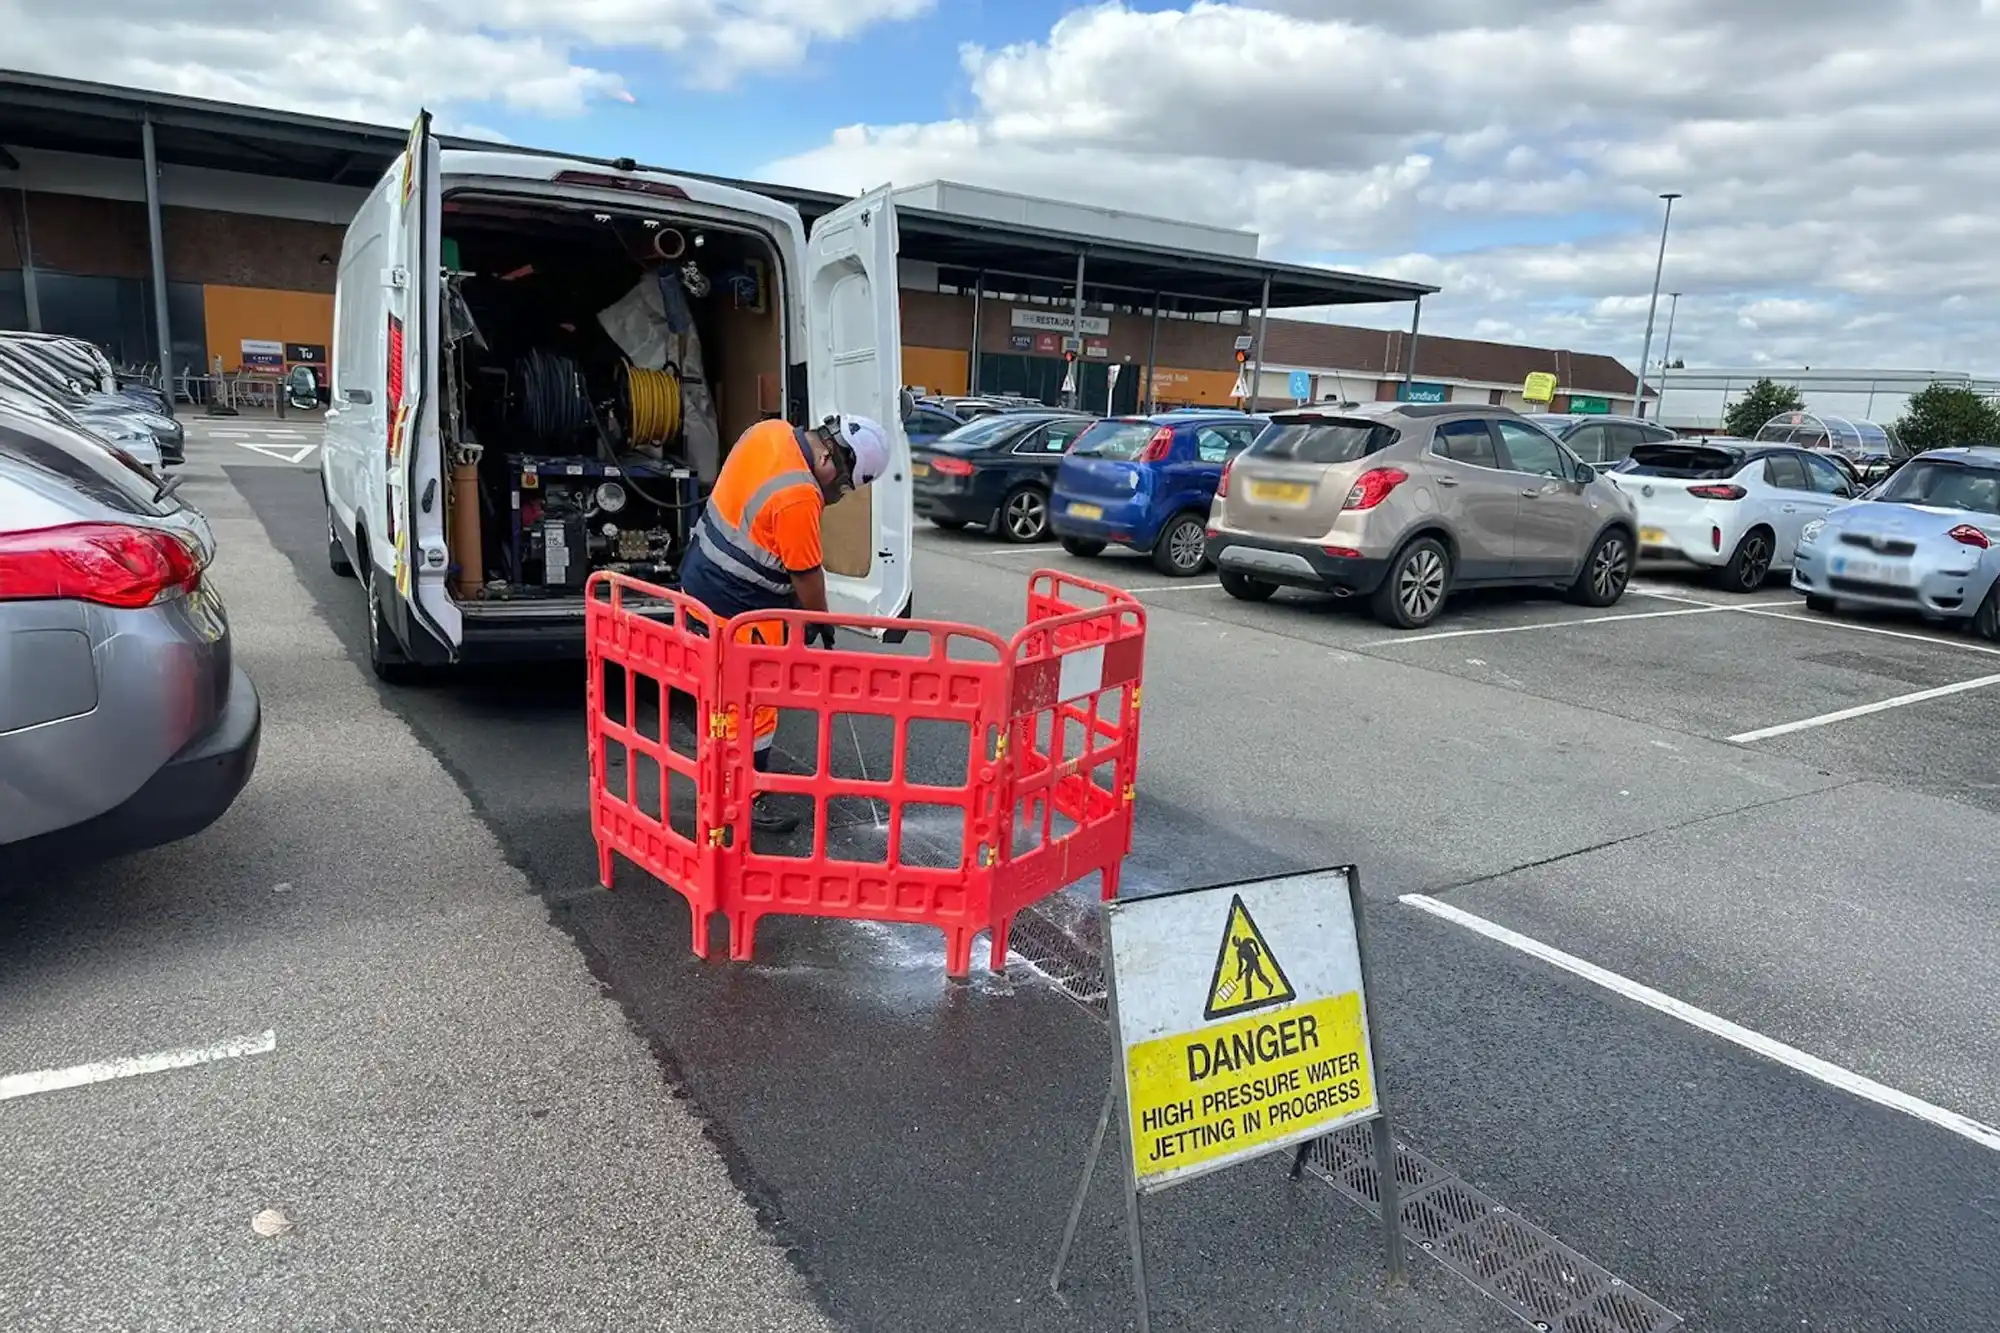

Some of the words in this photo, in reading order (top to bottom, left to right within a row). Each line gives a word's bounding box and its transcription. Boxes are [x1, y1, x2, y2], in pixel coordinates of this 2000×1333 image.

[298, 346, 313, 359] Tu
[1187, 1014, 1319, 1082] DANGER
[1142, 1100, 1194, 1132] HIGH
[1202, 1069, 1301, 1117] PRESSURE
[1306, 1052, 1360, 1085] WATER
[1149, 1118, 1235, 1162] JETTING
[1243, 1109, 1261, 1134] IN
[1268, 1079, 1361, 1126] PROGRESS
